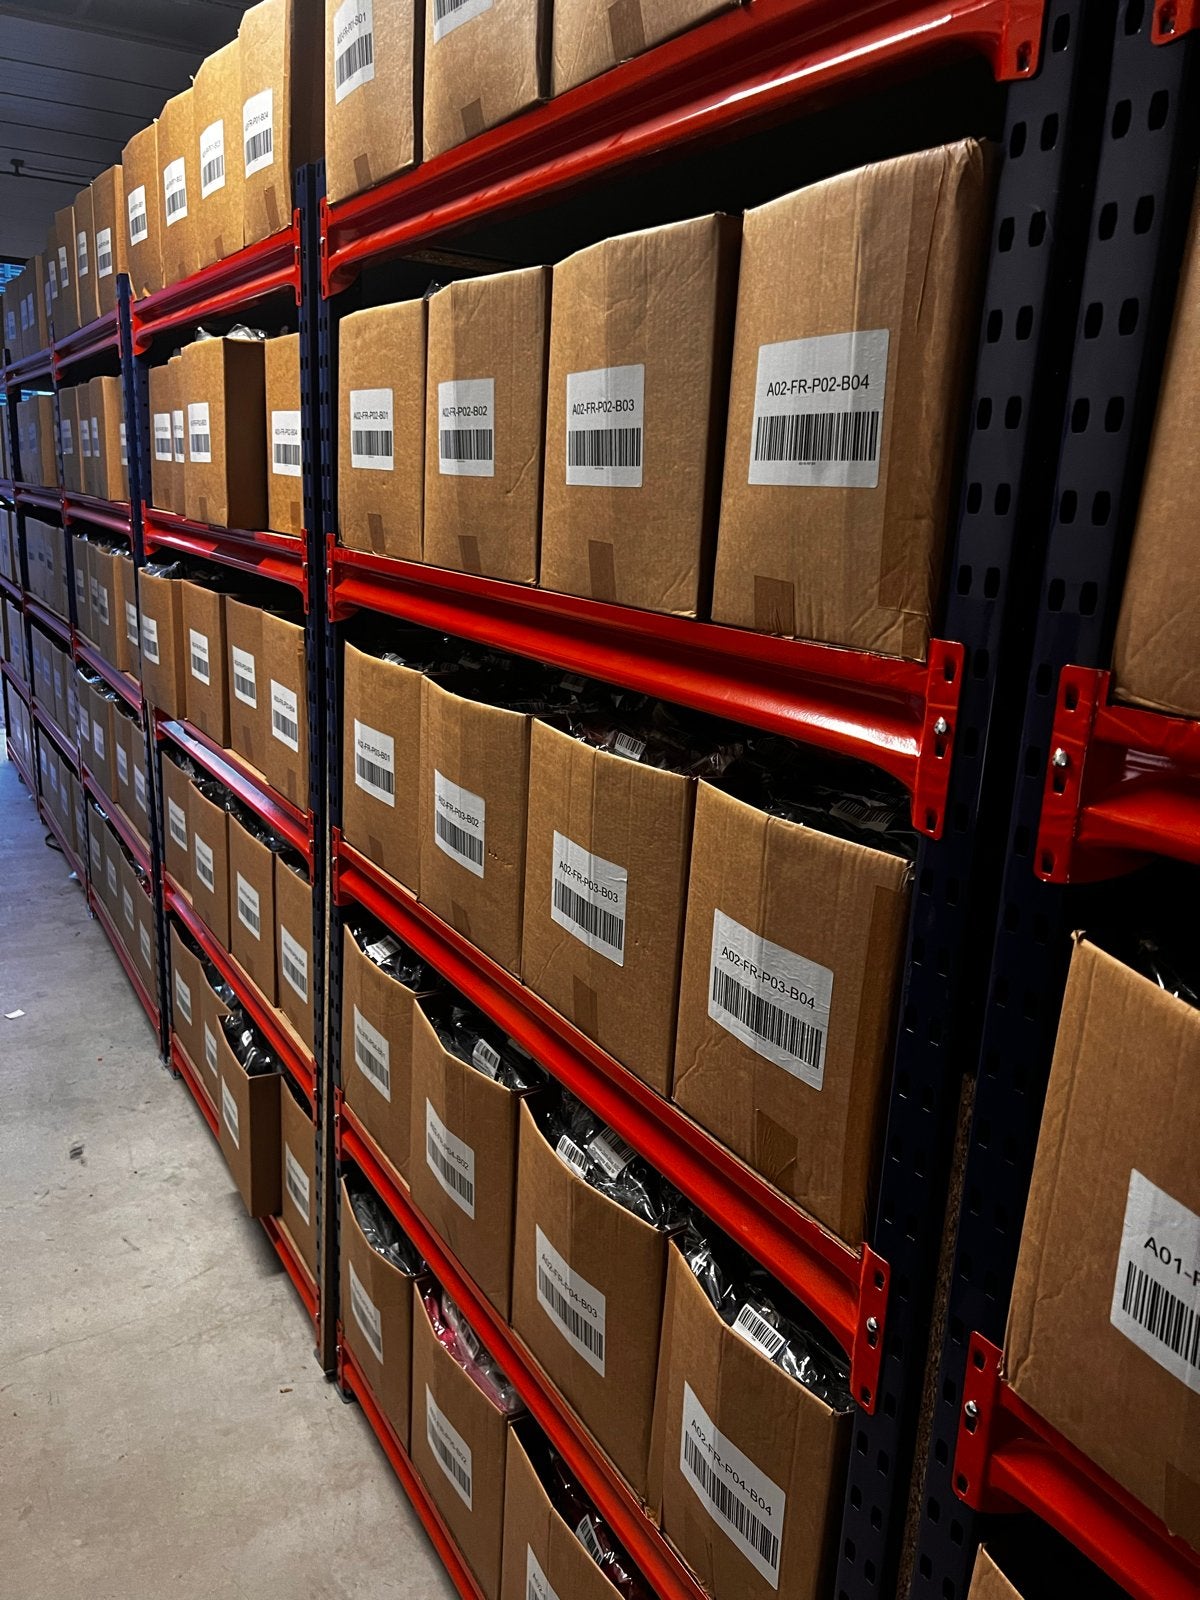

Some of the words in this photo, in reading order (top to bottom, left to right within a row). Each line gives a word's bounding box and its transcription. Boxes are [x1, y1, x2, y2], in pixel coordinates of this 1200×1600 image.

[572, 399, 634, 416] A02-FR-P02-B03
[766, 374, 870, 397] A02-FR-P02-B04
[559, 861, 619, 903] A02-FR-P03-B03
[721, 946, 816, 1010] A02-FR-P03-B04
[541, 1253, 598, 1319] A02-FR-P04-B03
[691, 1419, 773, 1516] A02-FR-P04-B04
